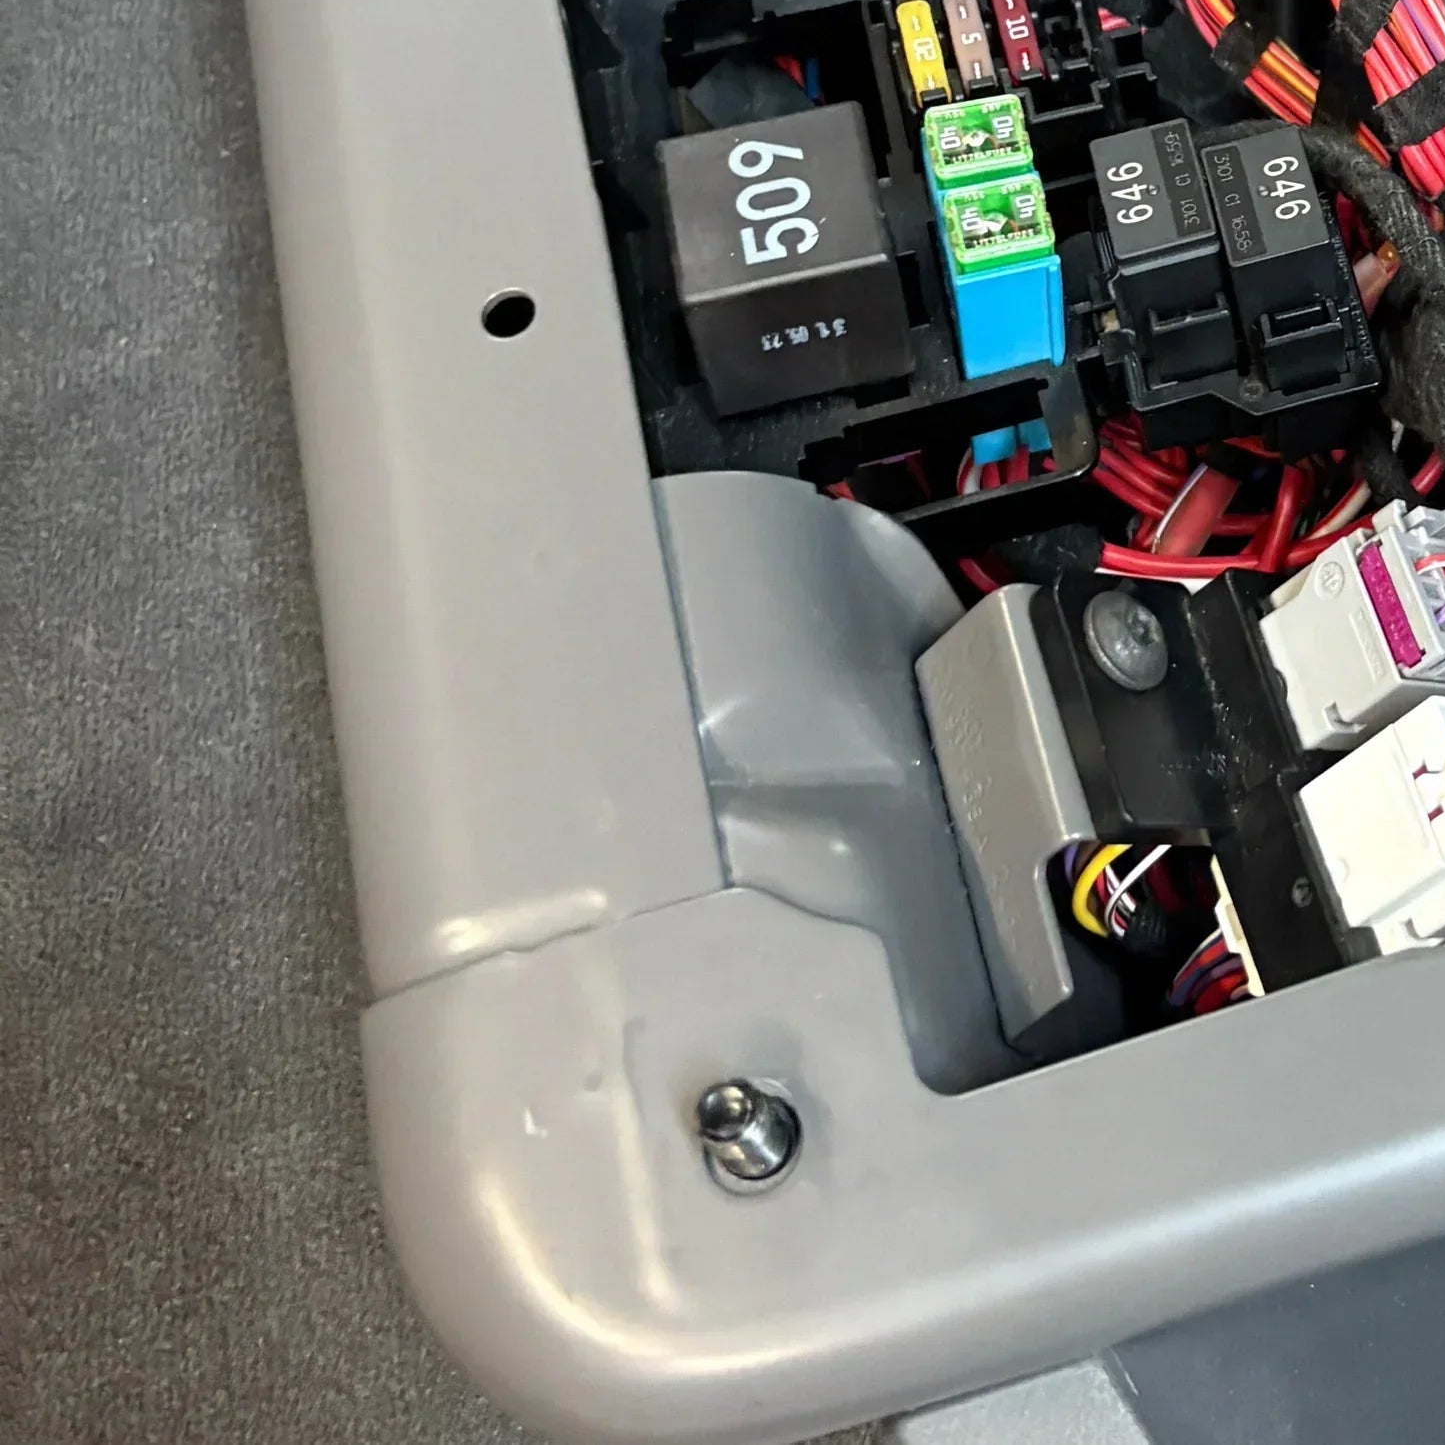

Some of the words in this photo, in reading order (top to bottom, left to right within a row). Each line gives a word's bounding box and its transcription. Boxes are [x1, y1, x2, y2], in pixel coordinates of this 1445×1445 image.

[962, 32, 982, 45] 5
[1006, 17, 1029, 40] 10
[915, 37, 938, 62] 20
[940, 126, 962, 150] 40
[992, 116, 1014, 138] 40
[1106, 162, 1153, 224] 646
[1263, 155, 1311, 220] 646
[728, 140, 820, 265] 509
[1015, 195, 1036, 218] 40
[961, 206, 984, 231] 40
